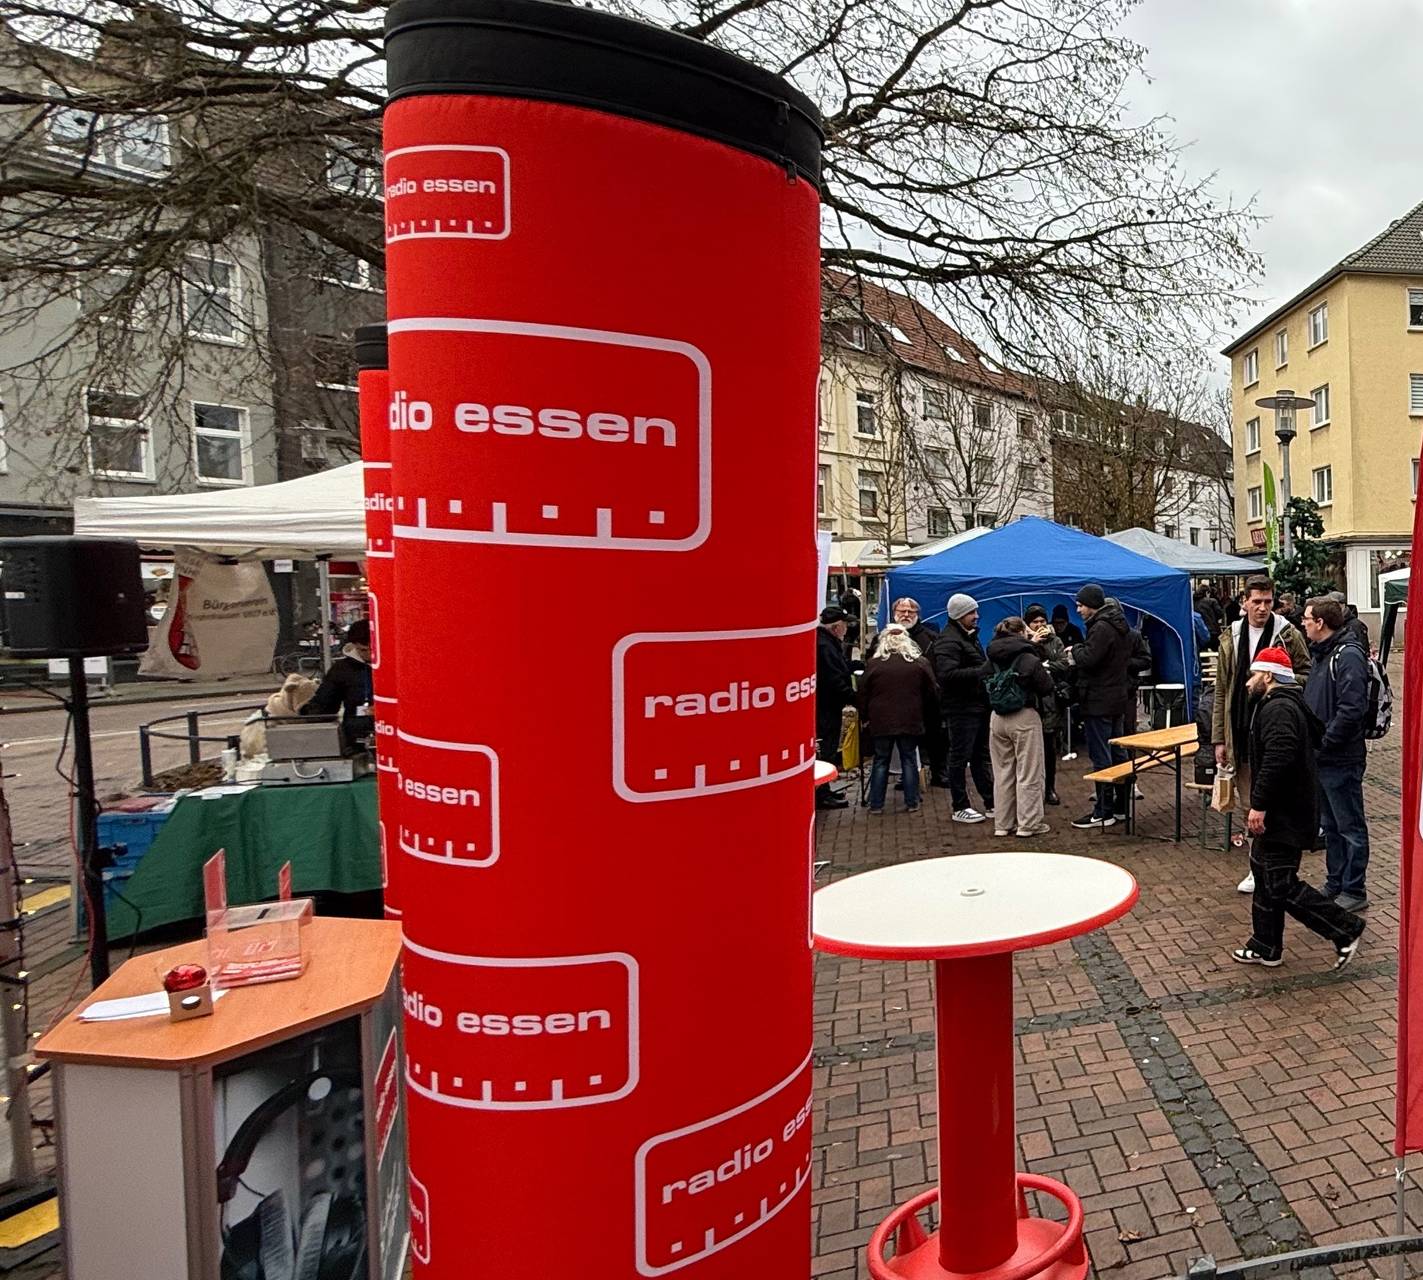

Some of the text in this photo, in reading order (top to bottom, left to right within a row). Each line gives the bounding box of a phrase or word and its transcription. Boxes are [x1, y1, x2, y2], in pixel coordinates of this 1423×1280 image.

[386, 177, 496, 200] radio essen
[389, 390, 677, 447] dio essen
[644, 672, 817, 718] radio ess
[404, 778, 481, 807] essen
[456, 1008, 611, 1036] essen
[662, 1092, 813, 1205] radio ess
